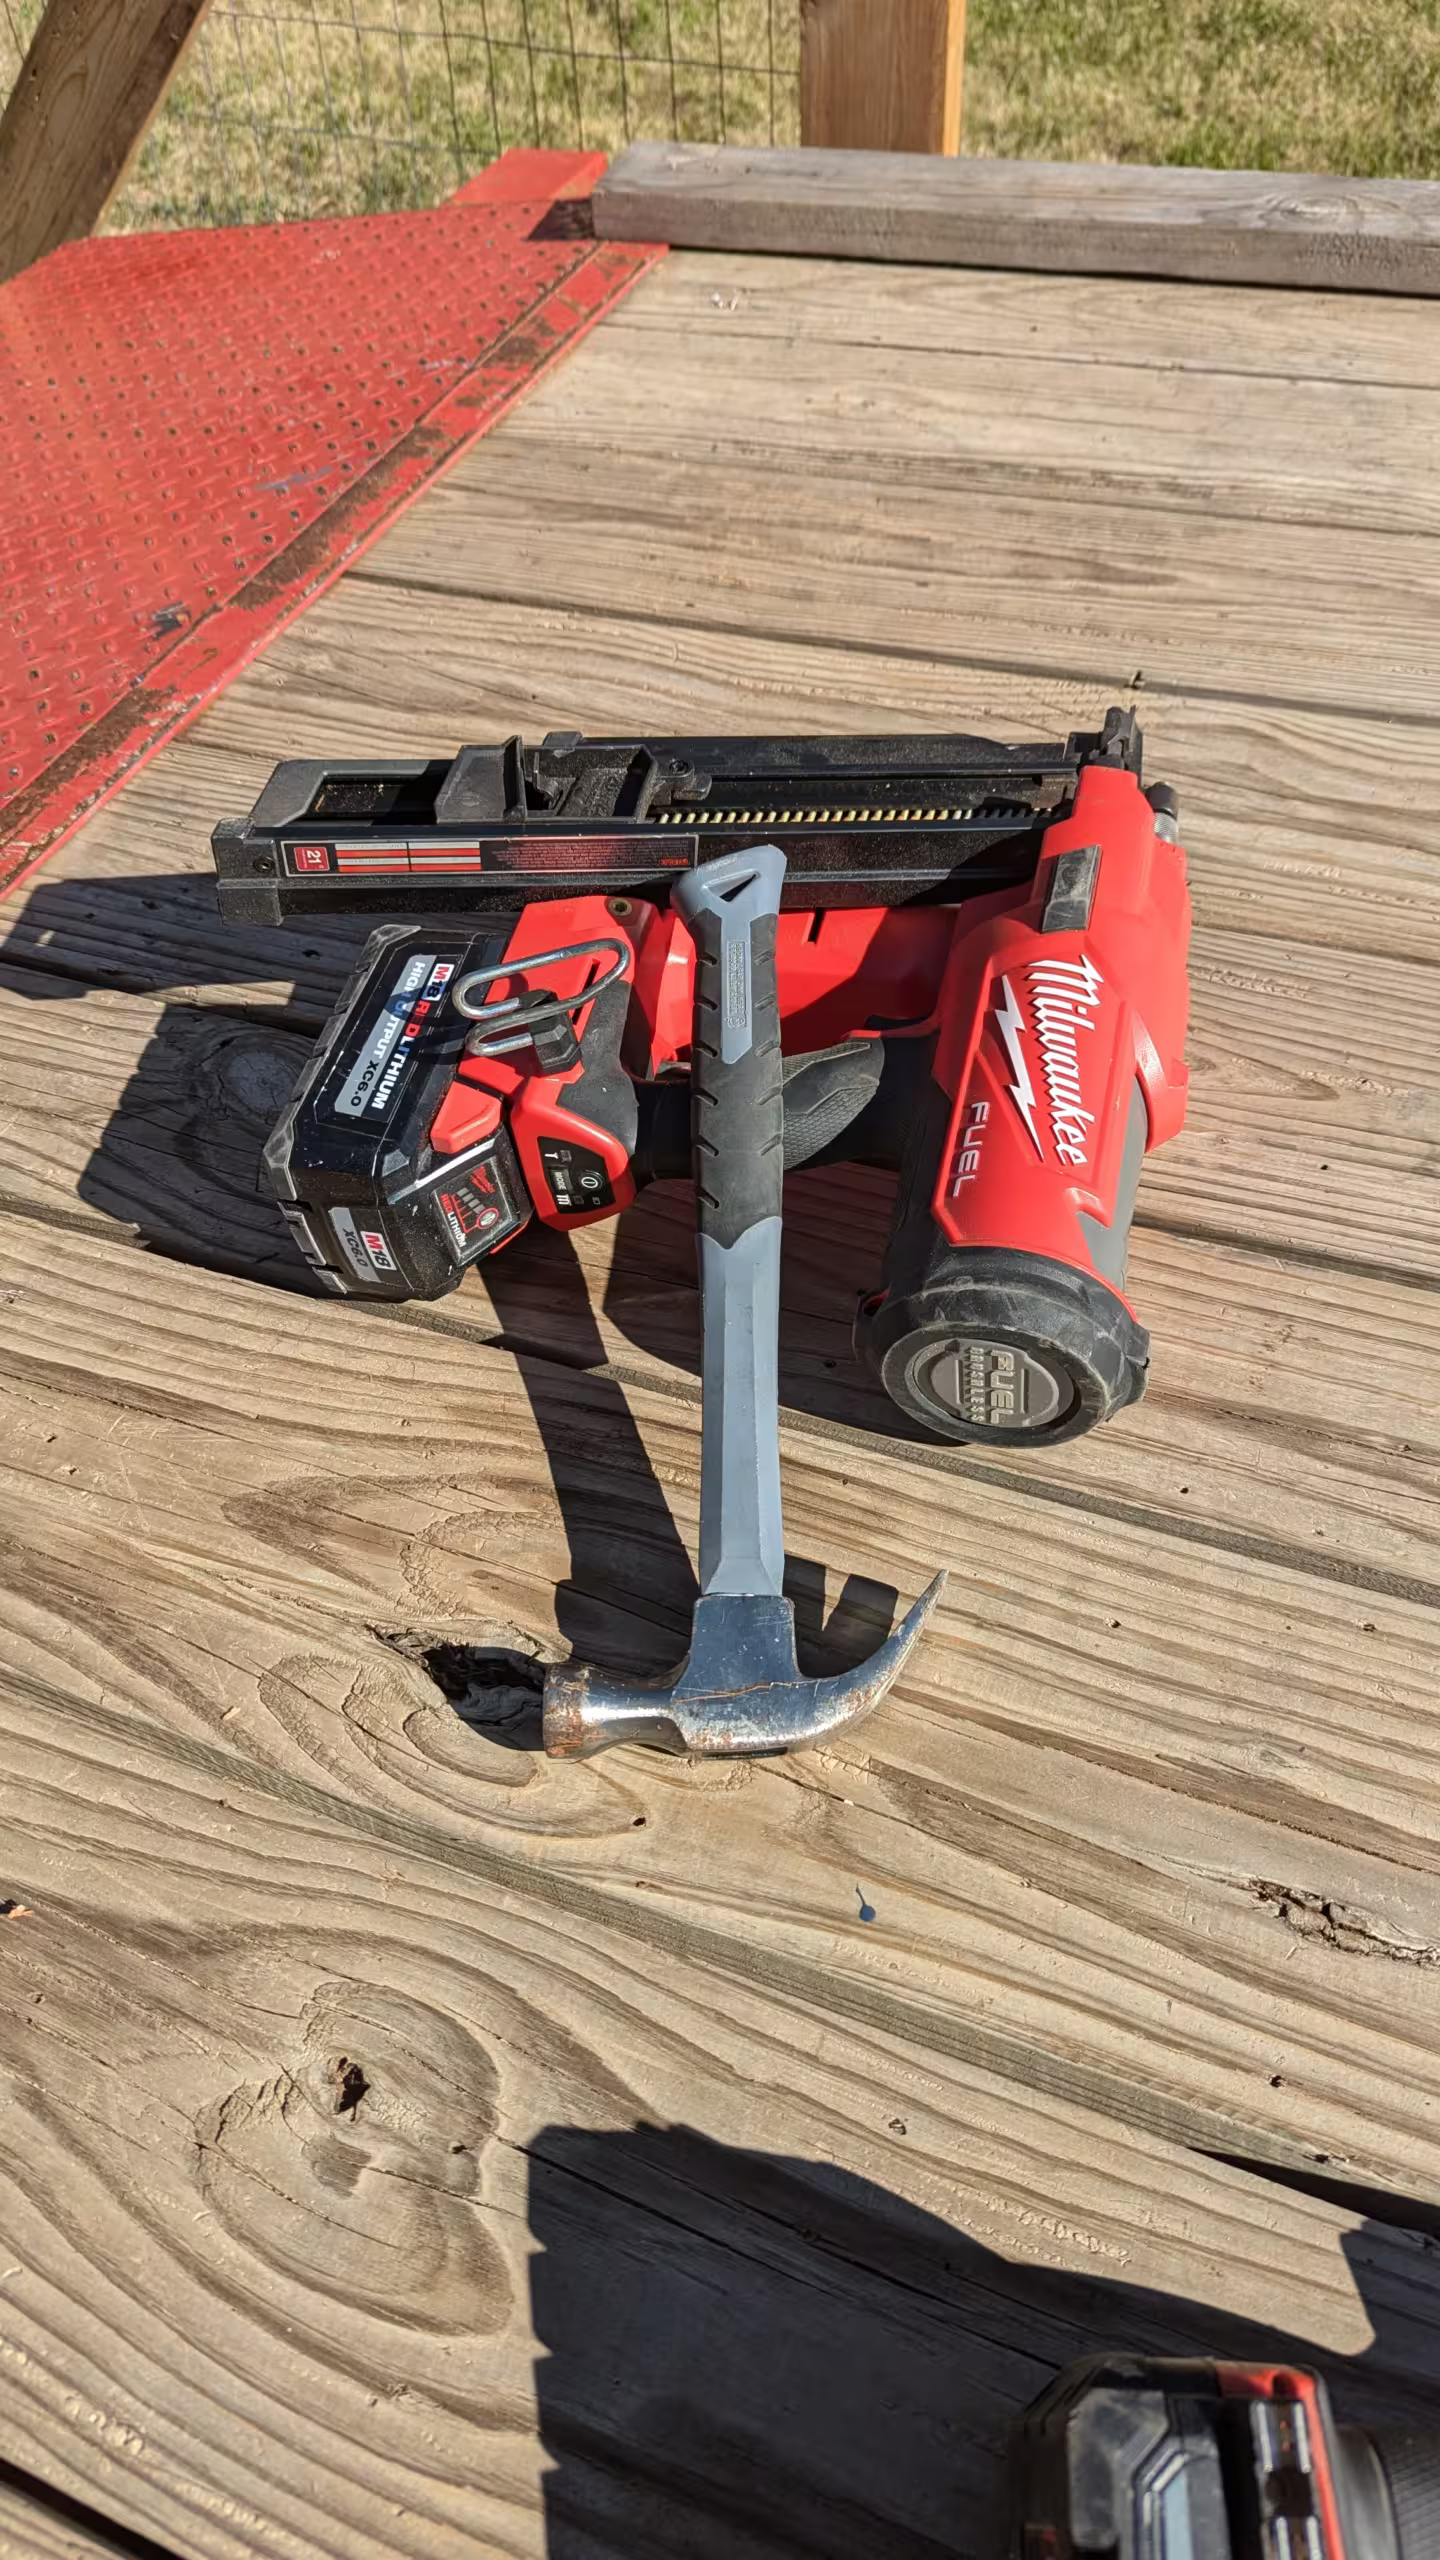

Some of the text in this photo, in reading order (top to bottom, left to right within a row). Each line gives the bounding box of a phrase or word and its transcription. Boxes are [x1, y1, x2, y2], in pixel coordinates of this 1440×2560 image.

[426, 966, 451, 998] M18
[350, 961, 426, 1107] HIGH OUTPUT XC6.0
[1027, 953, 1105, 1166] Milwaukee
[952, 1101, 990, 1198] FUEL
[342, 1228, 368, 1267] XC6.0
[364, 1234, 391, 1267] M18
[969, 1346, 985, 1422] BRUSHLESS
[990, 1349, 1015, 1424] FUEL
